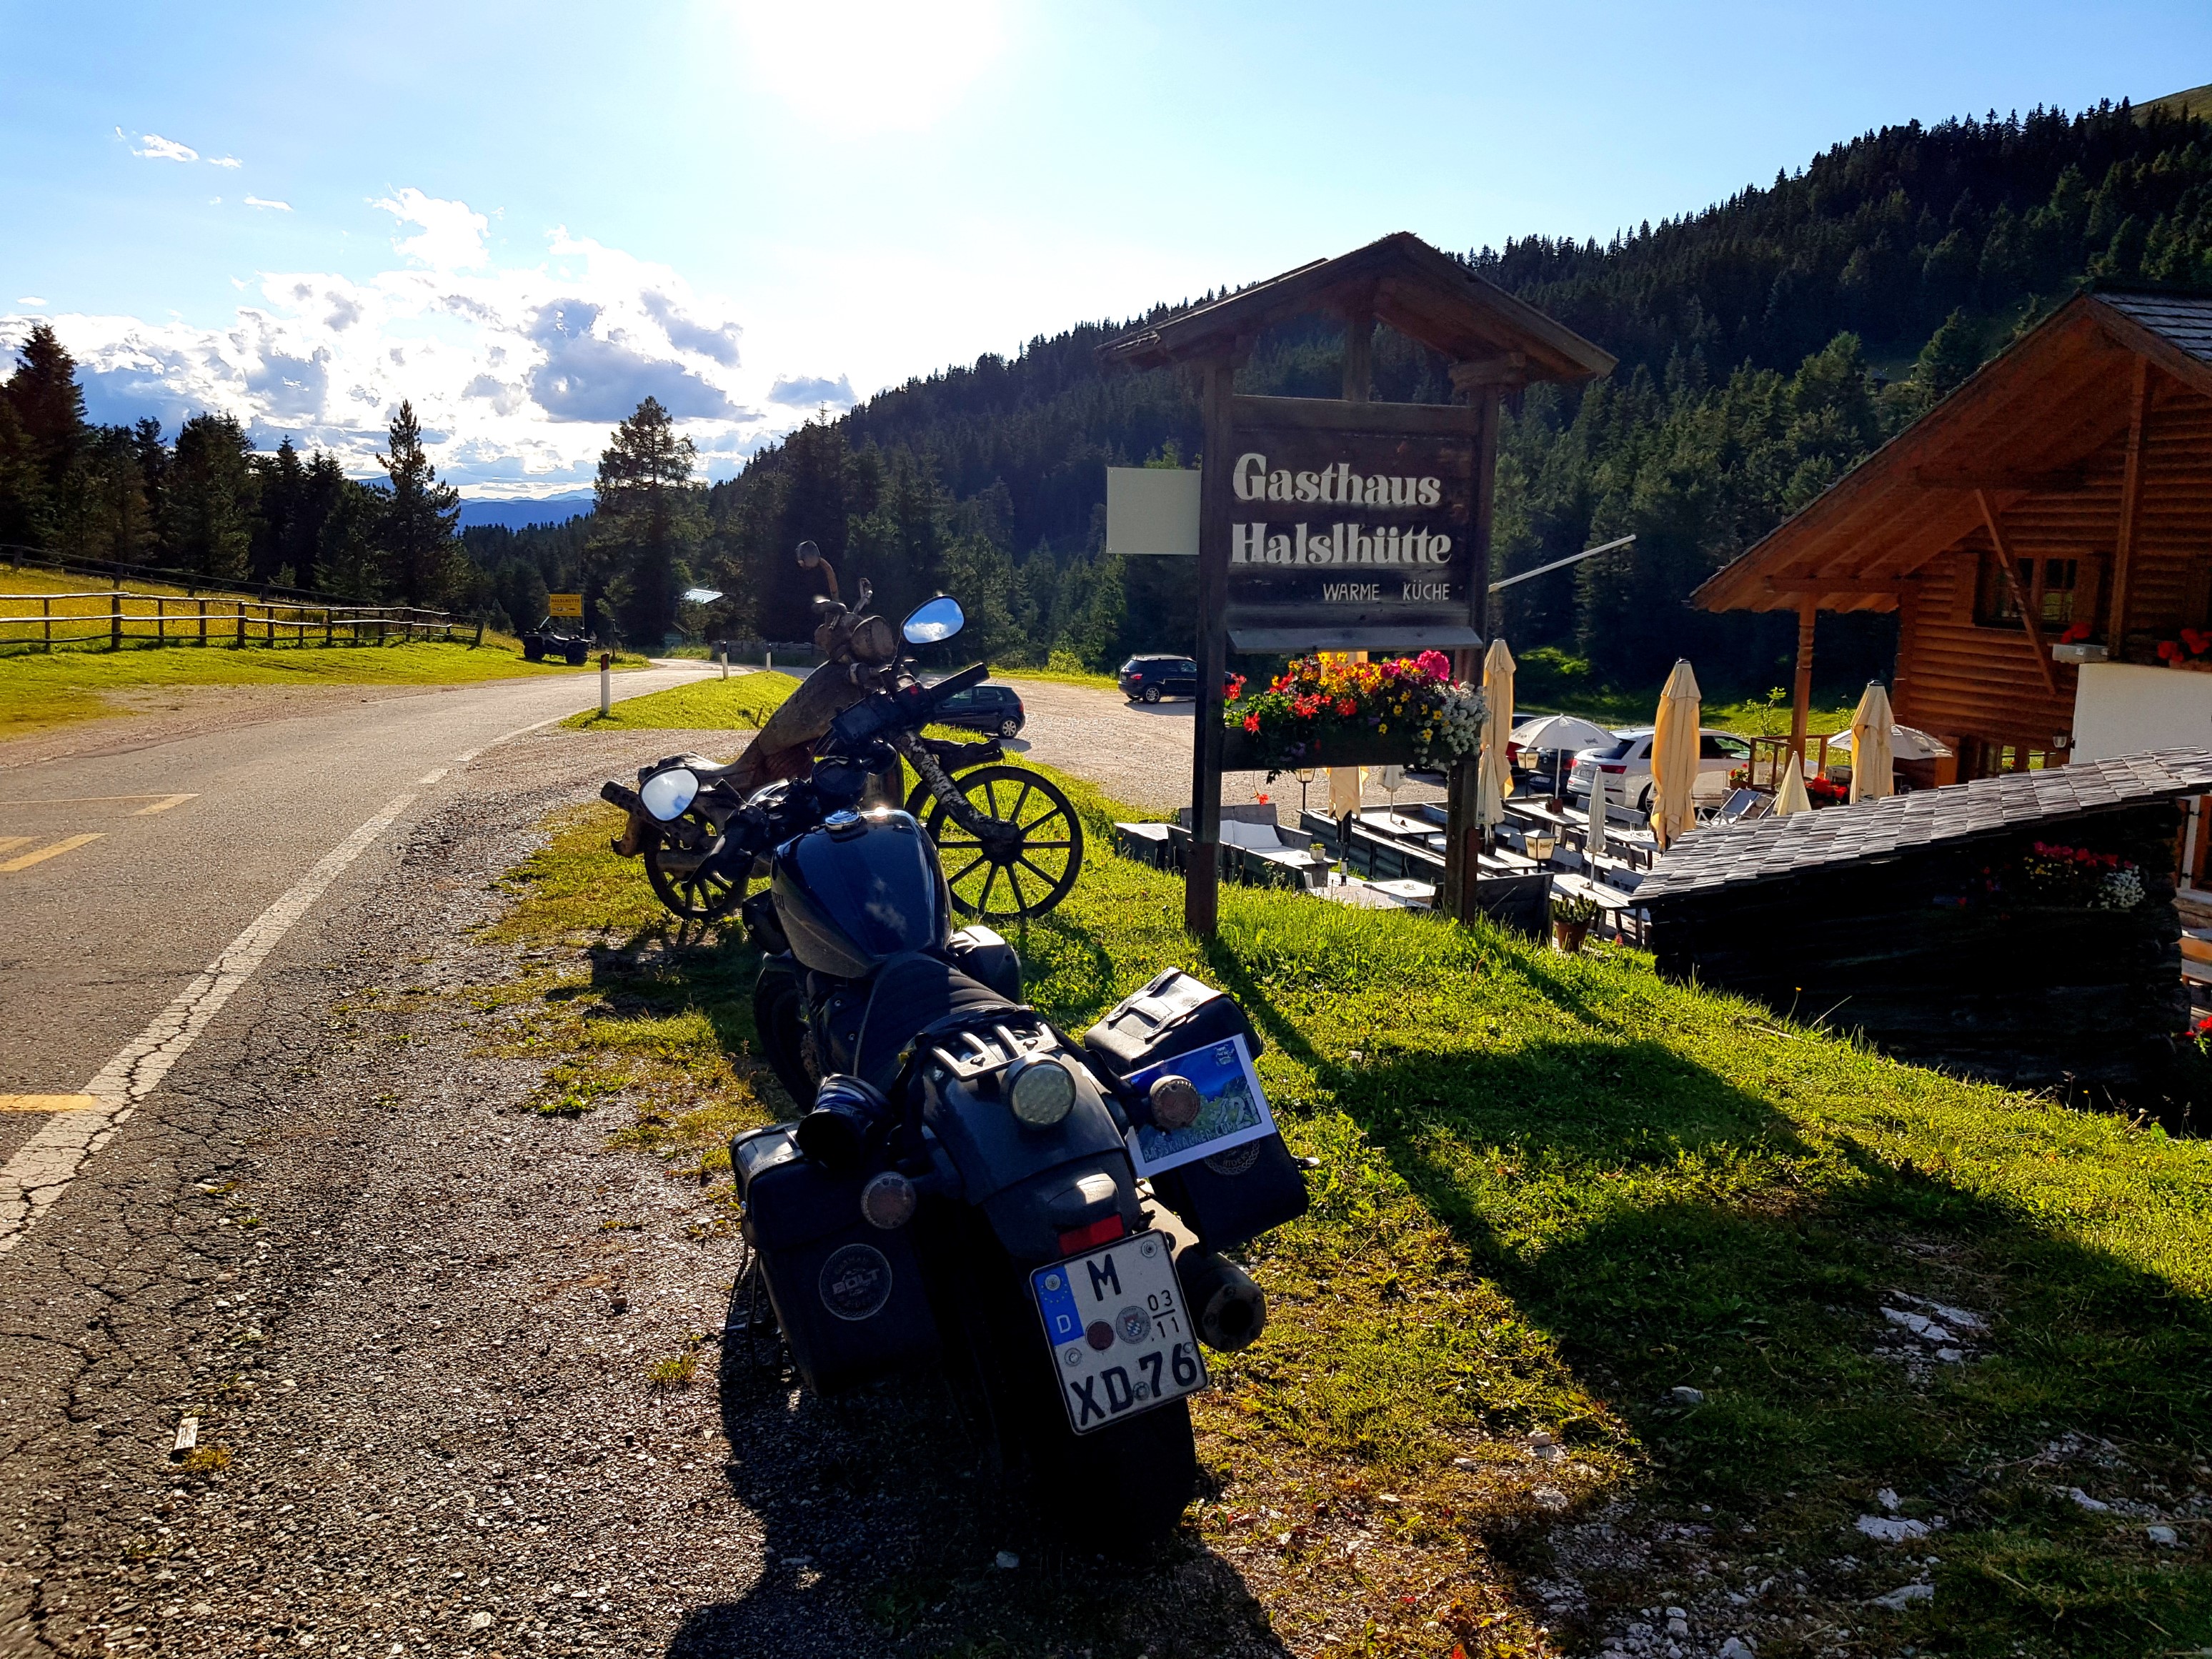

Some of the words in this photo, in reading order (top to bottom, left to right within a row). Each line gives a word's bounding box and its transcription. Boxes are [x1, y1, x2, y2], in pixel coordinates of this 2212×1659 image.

[1232, 453, 1441, 505] Gasthaus
[1232, 522, 1452, 564] Halslhütte
[1323, 584, 1380, 601] WARME
[1403, 579, 1451, 601] KÜCHE
[832, 1268, 880, 1295] BOLT
[1086, 1253, 1122, 1302] M
[1147, 1290, 1172, 1312] 03
[1056, 1314, 1071, 1334] D
[1156, 1317, 1180, 1338] 11
